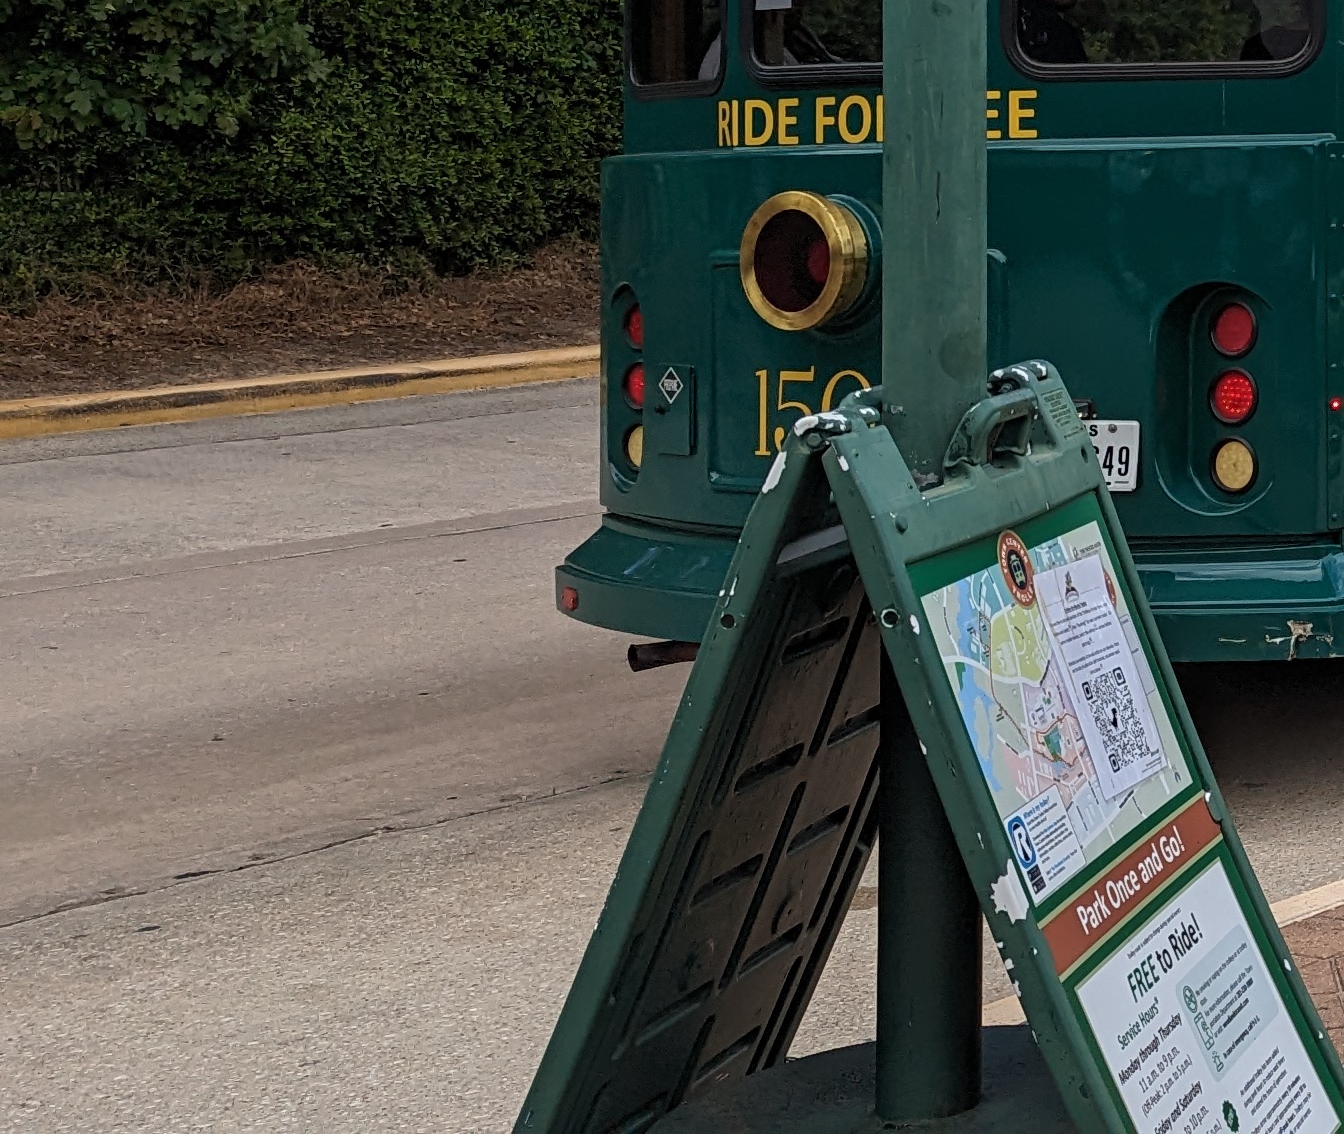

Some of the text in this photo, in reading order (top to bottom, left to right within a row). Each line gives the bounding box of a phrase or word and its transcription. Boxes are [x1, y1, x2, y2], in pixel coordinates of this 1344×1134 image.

[718, 97, 799, 147] RIDE
[1076, 895, 1111, 936] Park
[1105, 870, 1141, 910] Once
[1136, 843, 1164, 884] and
[1159, 825, 1186, 863] Go!
[1127, 954, 1157, 1004] FREE
[1156, 950, 1171, 975] to
[1168, 912, 1204, 965] Ride!
[1117, 1020, 1142, 1050] Service
[1118, 1012, 1183, 1086] Monday through Thursday
[1138, 1077, 1149, 1093] 11
[1156, 1062, 1166, 1074] to
[1161, 1054, 1169, 1065] 9
[1160, 1083, 1167, 1096] 2
[1172, 1070, 1179, 1081] to
[1170, 1100, 1182, 1123] and
[1179, 1080, 1203, 1111] Saturday
[1188, 1114, 1199, 1131] 10
